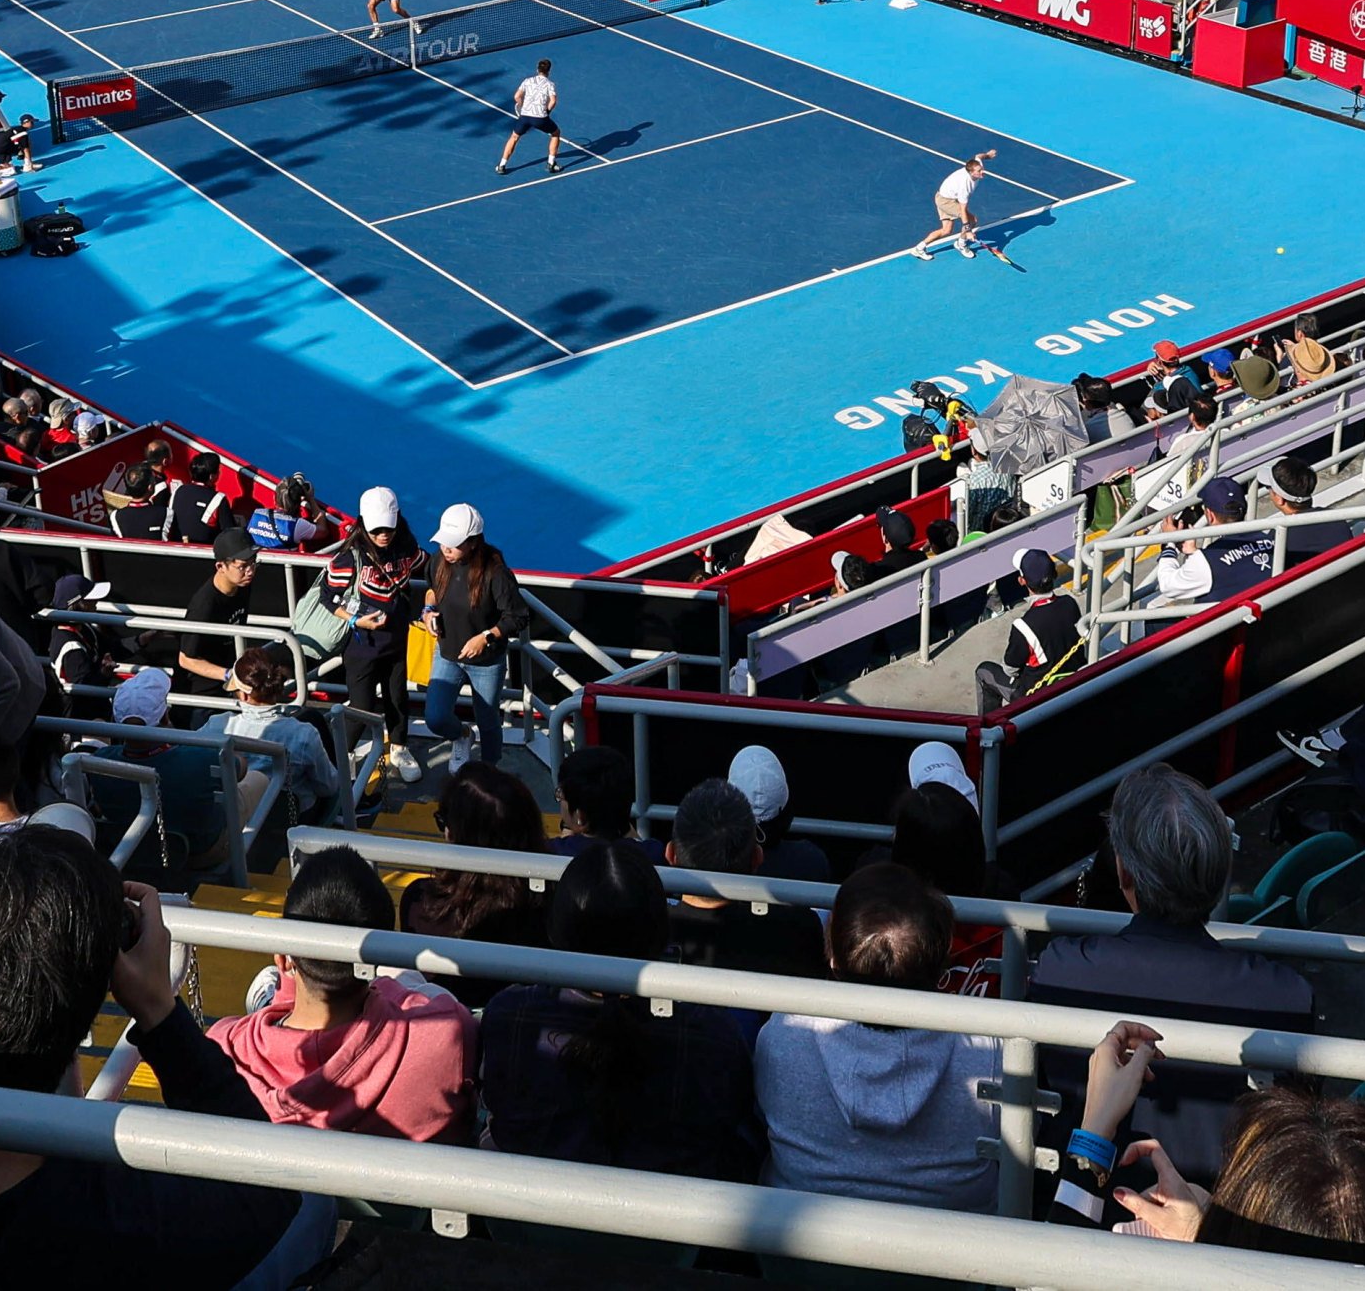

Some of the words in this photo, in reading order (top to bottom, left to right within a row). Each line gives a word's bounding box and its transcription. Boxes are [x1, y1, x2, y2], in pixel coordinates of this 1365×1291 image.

[1139, 16, 1153, 29] HK
[1139, 26, 1153, 38] TS
[417, 33, 480, 63] TOUR
[1307, 39, 1347, 74] 香港
[64, 88, 133, 111] Emirates
[1034, 293, 1195, 356] HONG
[70, 483, 105, 512] HK
[1051, 483, 1064, 501] S9
[1167, 480, 1182, 500] S8
[73, 506, 105, 523] TS
